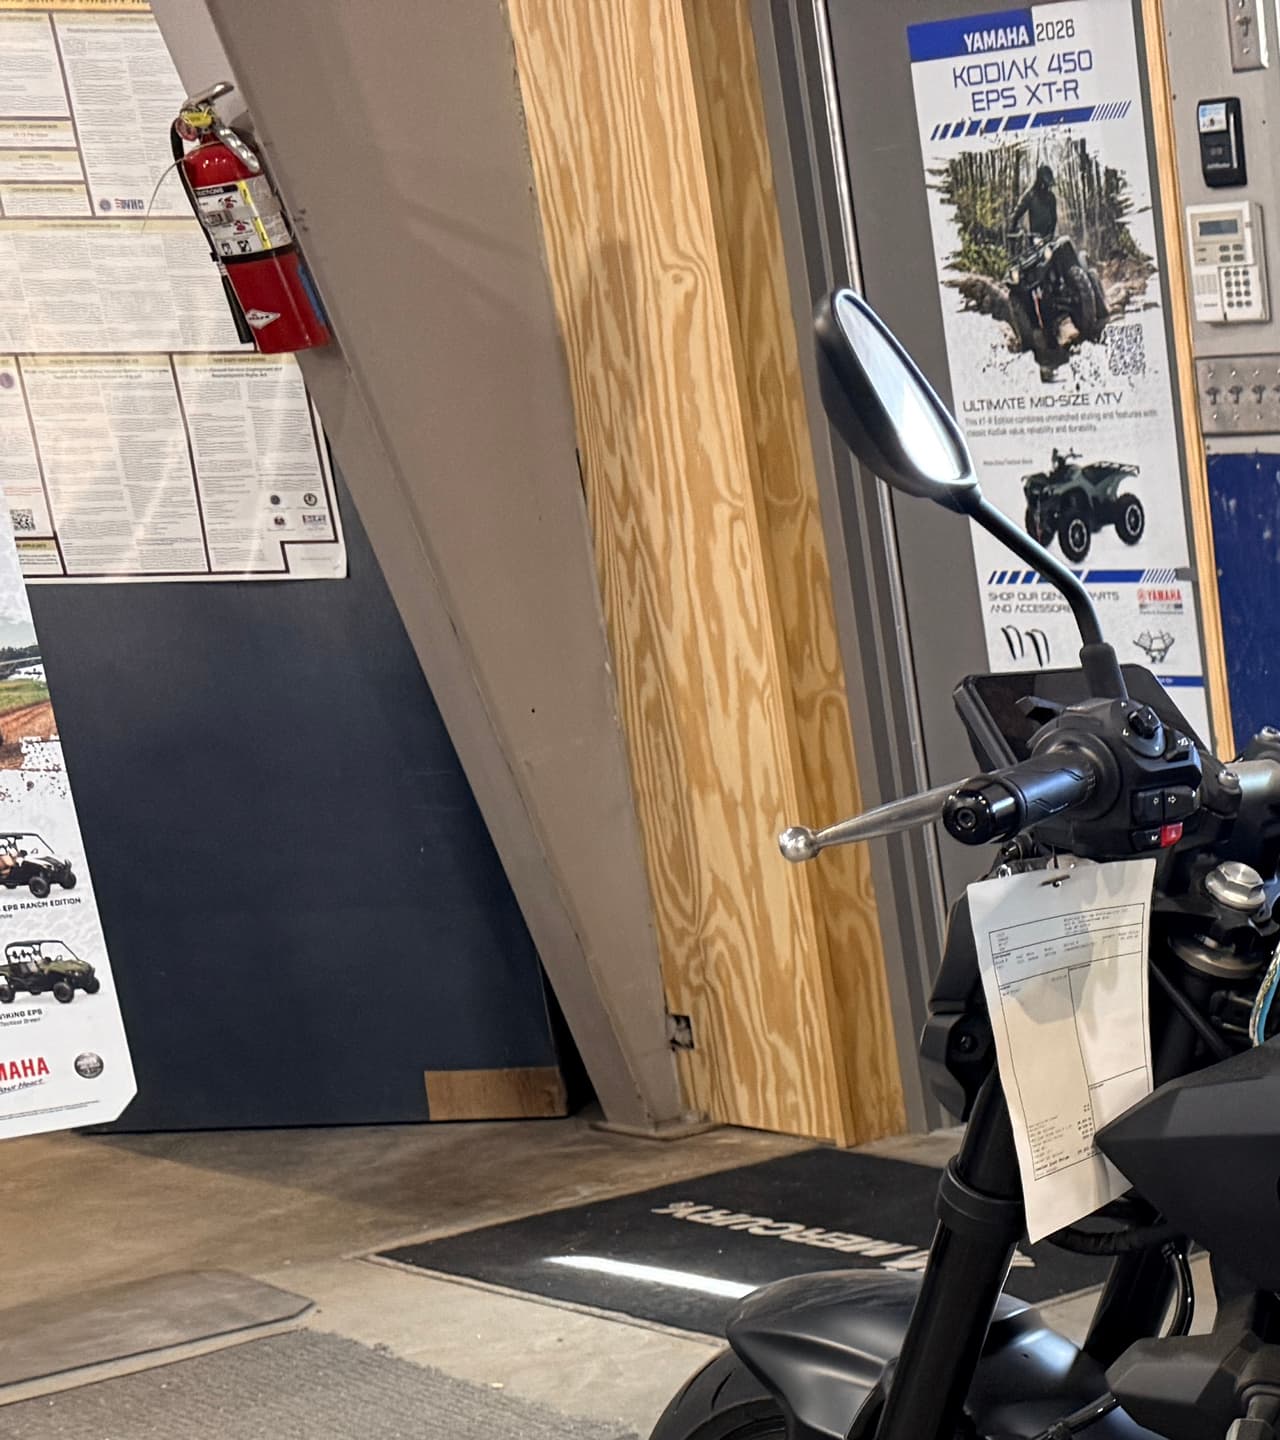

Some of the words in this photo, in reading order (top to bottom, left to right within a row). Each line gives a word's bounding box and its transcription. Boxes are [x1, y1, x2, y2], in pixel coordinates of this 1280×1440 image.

[963, 25, 1029, 53] YAMAHA
[953, 56, 1040, 88] KODIAK
[1048, 49, 1093, 74] 450
[971, 87, 1017, 112] EPS
[1025, 79, 1079, 106] XT-R
[963, 397, 1026, 413] ULTIMATE
[1030, 393, 1090, 409] MID-SIZE
[1095, 391, 1124, 405] ATV
[0, 1056, 50, 1081] MAHA
